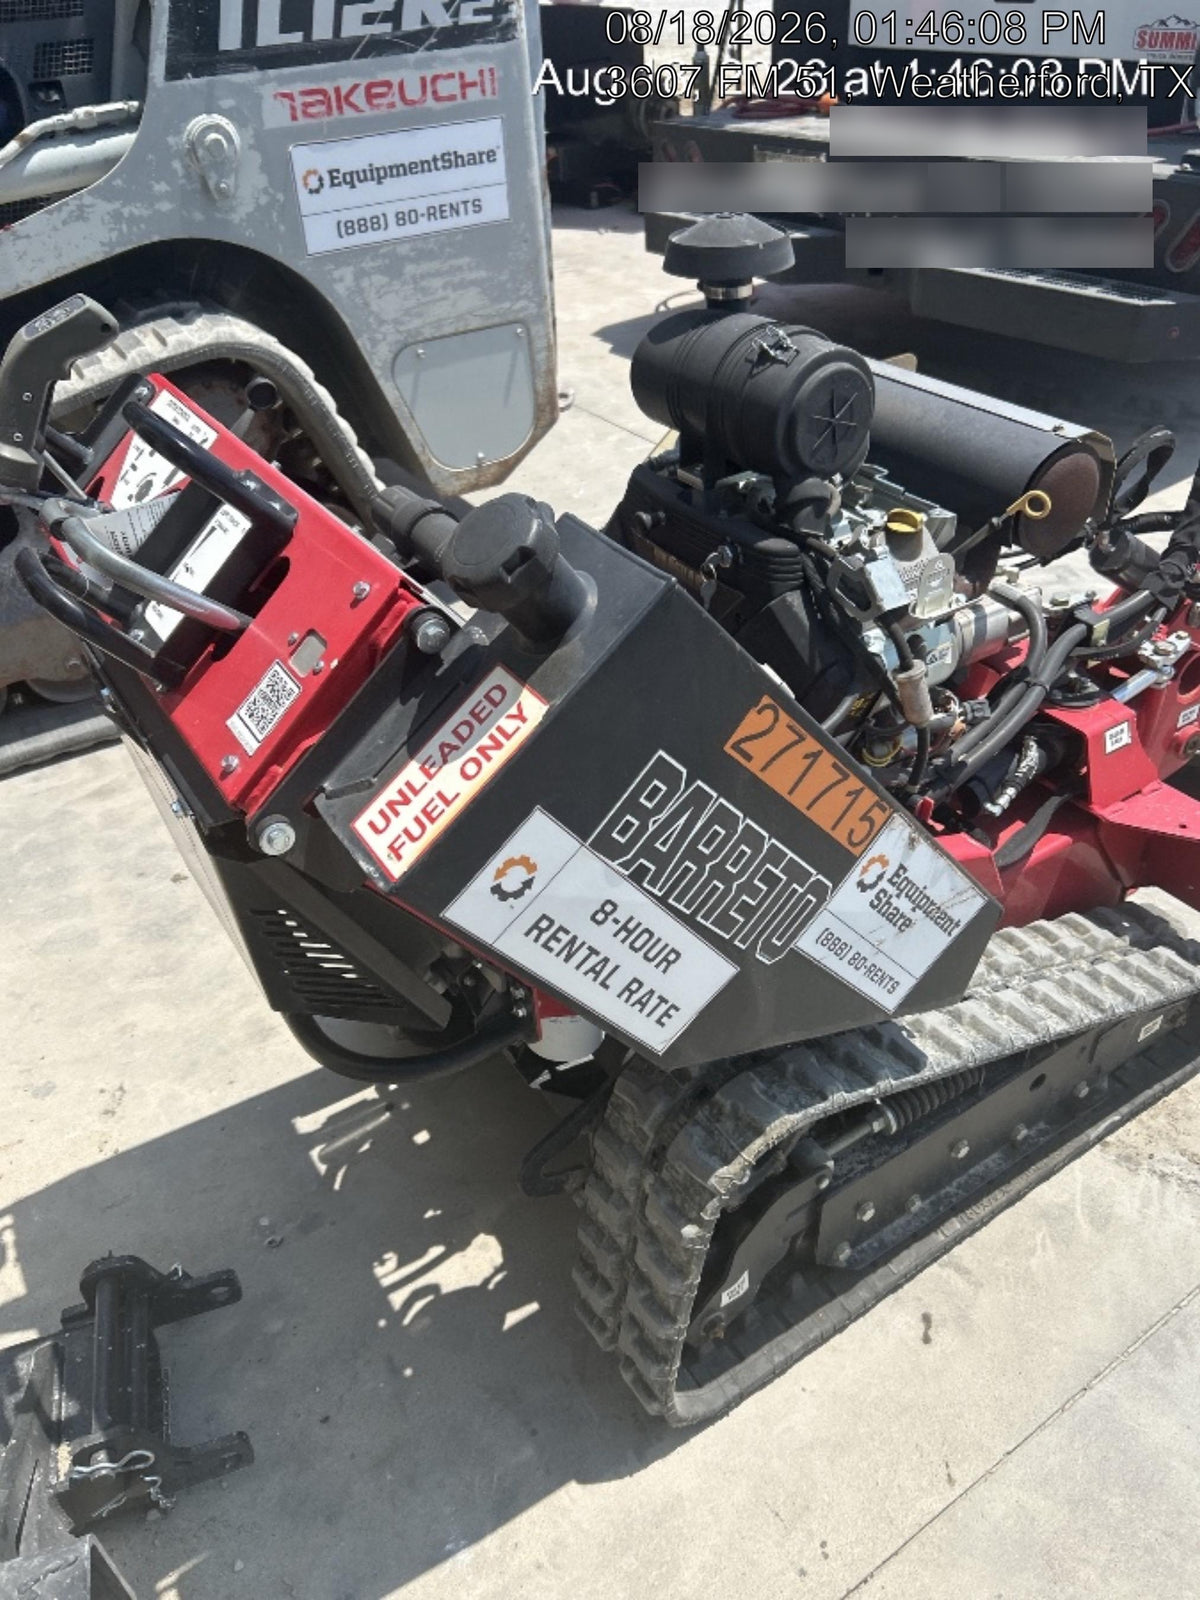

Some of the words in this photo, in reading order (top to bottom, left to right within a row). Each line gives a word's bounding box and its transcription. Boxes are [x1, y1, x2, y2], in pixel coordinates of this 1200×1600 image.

[1136, 29, 1197, 49] SUMMI
[326, 148, 498, 189] EquipmentShare
[336, 212, 389, 239] (888)
[395, 198, 483, 227] 80-RENTS
[367, 683, 508, 836] UNLEADED
[386, 789, 461, 862] FUEL
[459, 701, 529, 782] ONLY
[730, 703, 888, 848] 271715
[587, 749, 833, 965] BARRETO
[589, 899, 682, 975] 8-HOUR
[868, 887, 914, 934] Share
[886, 863, 962, 938] Equipment
[523, 913, 621, 991] RENTAL
[616, 976, 681, 1029] RATE
[815, 926, 852, 962] (888)
[847, 951, 900, 995] 80-RENTS
